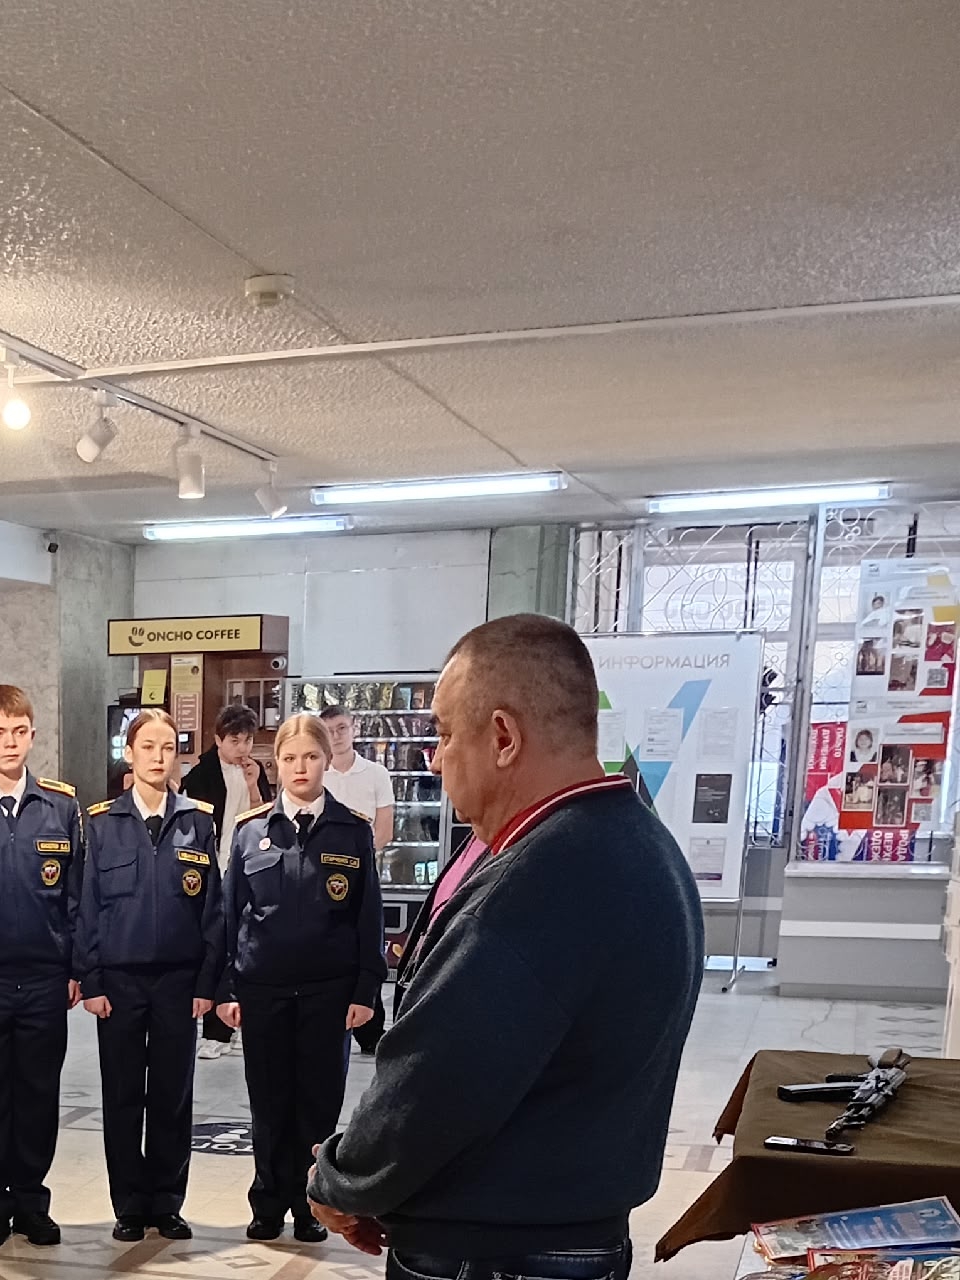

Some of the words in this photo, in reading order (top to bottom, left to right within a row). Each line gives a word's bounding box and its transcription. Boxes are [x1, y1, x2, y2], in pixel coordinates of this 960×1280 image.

[146, 630, 193, 643] ONCHO
[195, 628, 241, 641] COFFEE
[598, 653, 730, 670] ИНФОРМАЦИЯ
